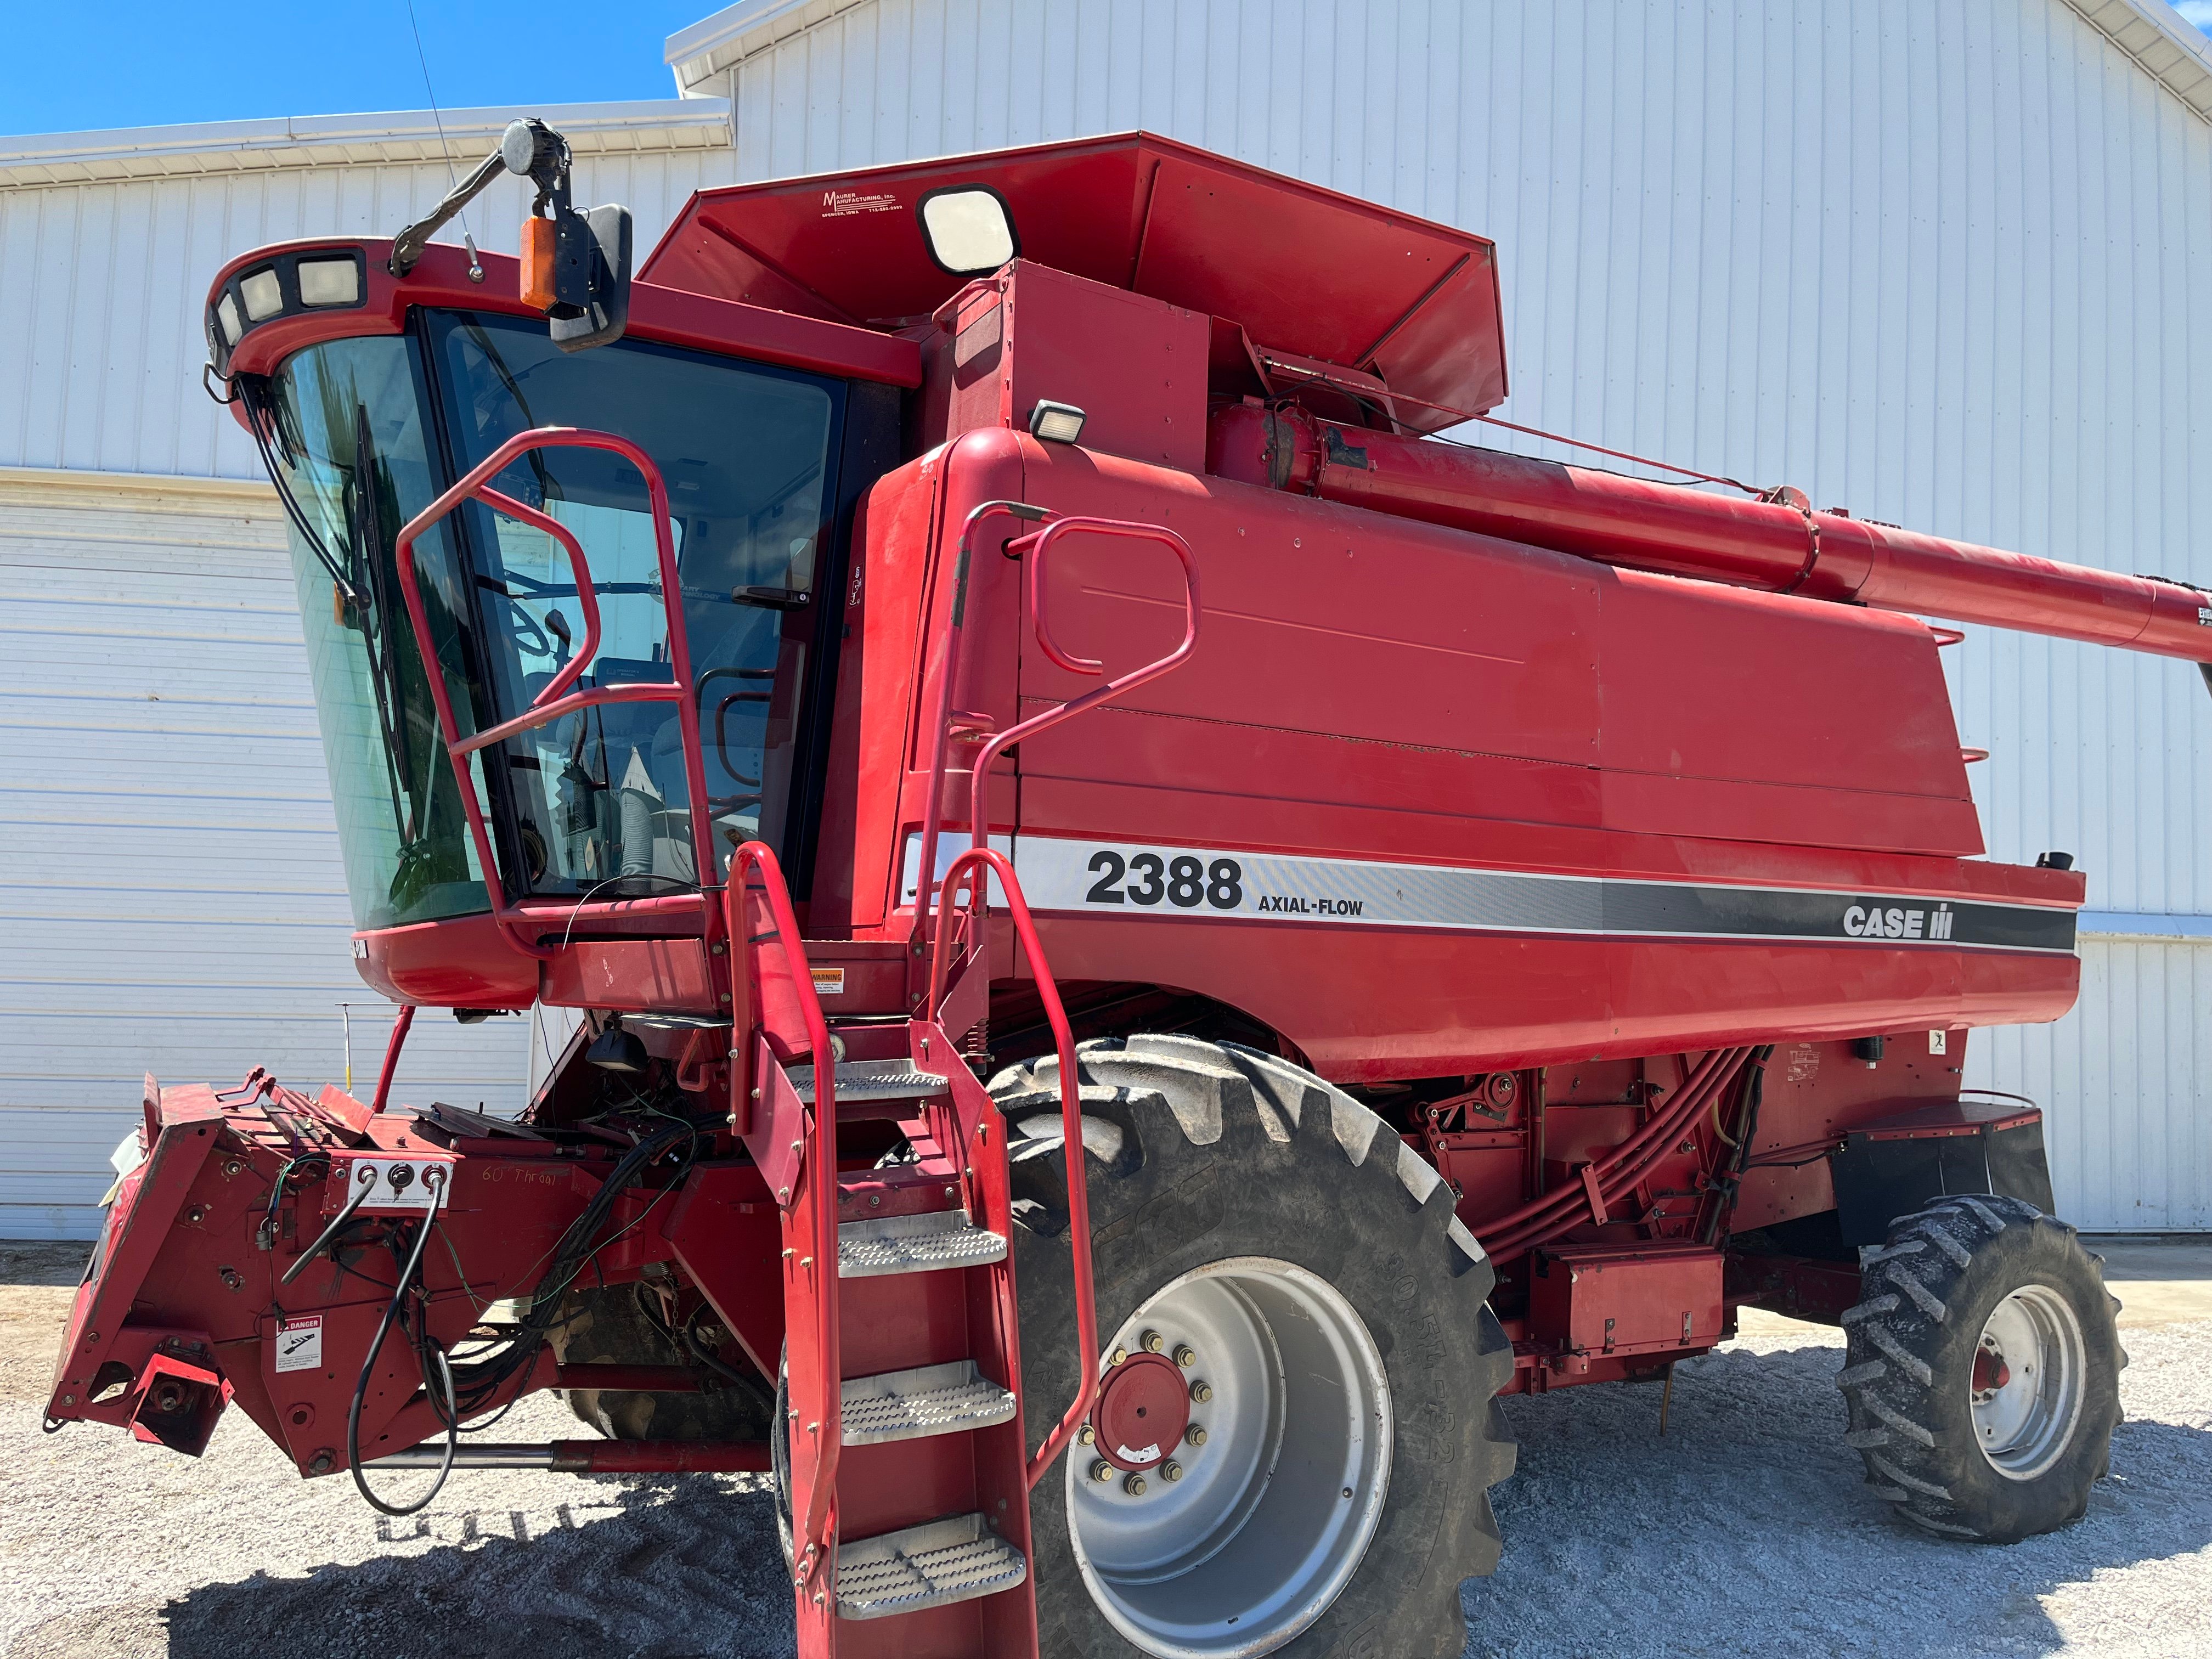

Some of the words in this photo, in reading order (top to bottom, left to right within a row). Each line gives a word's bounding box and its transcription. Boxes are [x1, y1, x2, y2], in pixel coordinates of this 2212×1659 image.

[1086, 850, 1242, 909] 2388
[1258, 895, 1363, 916] AXIAL-FLOW
[1843, 905, 1925, 939] CASE
[291, 1320, 318, 1329] DANGER
